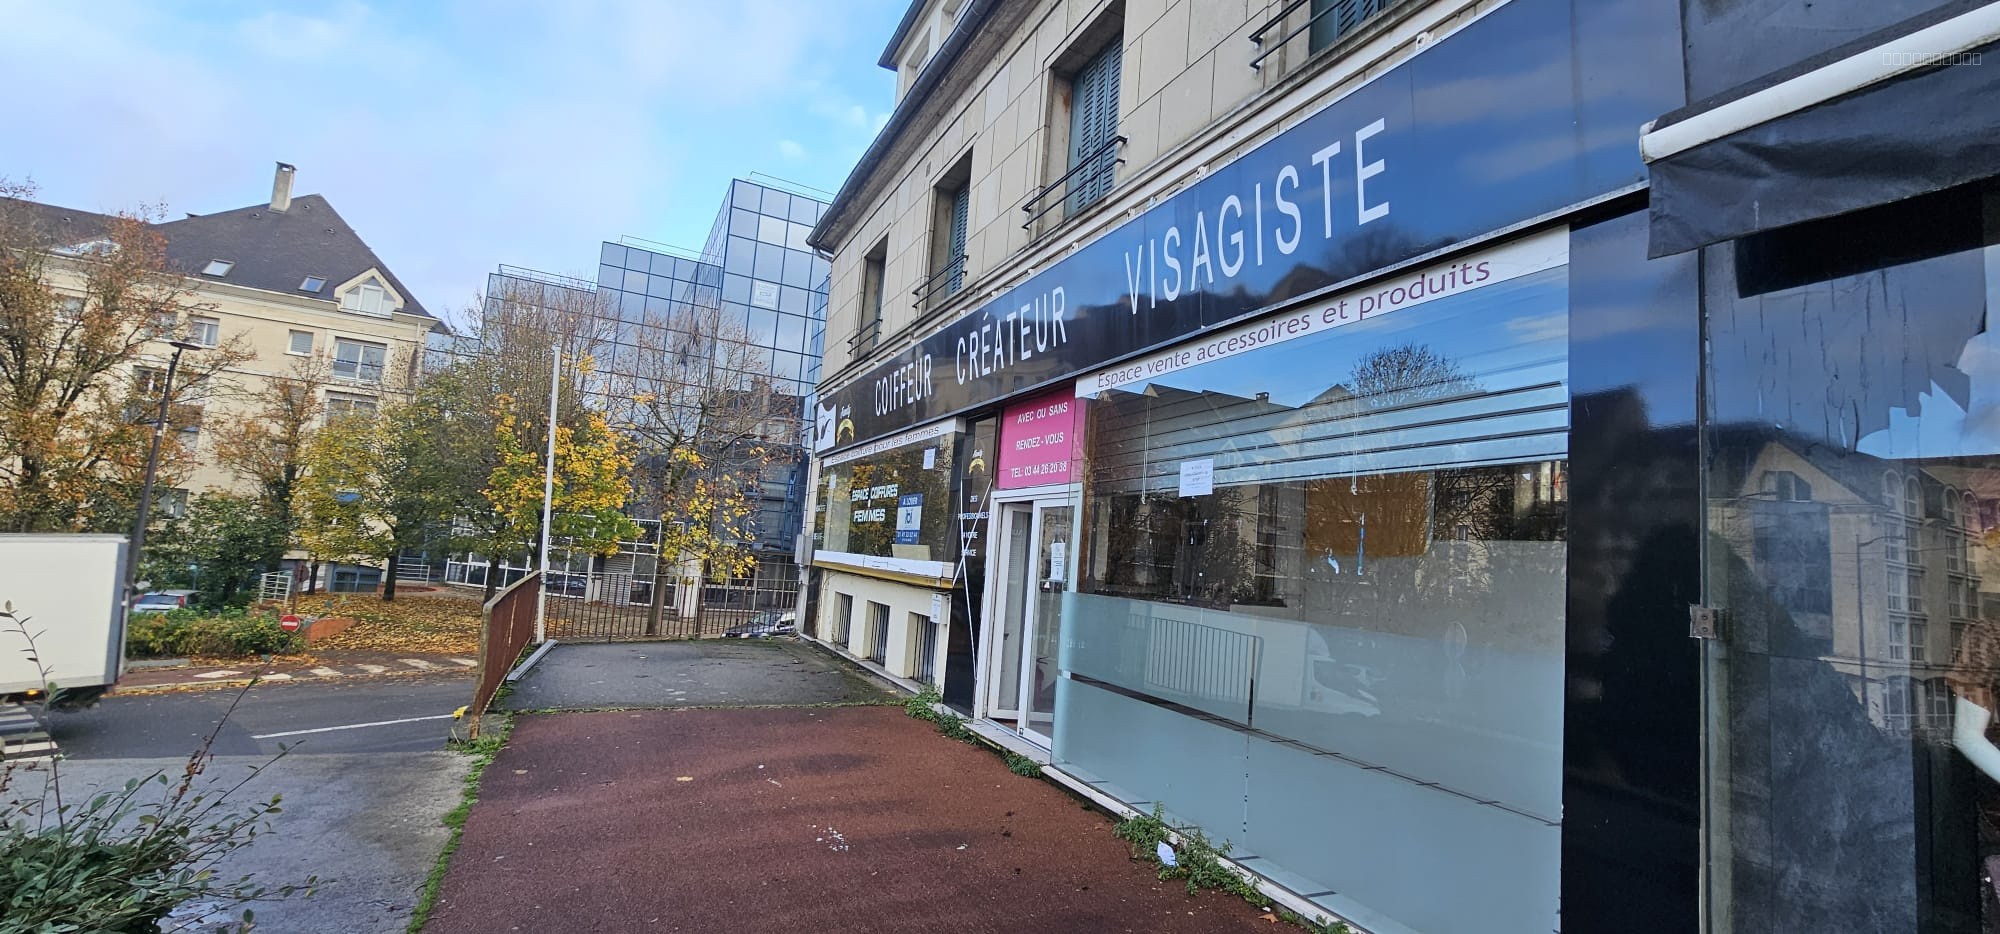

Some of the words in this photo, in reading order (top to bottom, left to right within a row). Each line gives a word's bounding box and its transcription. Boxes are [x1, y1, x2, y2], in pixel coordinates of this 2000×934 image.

[875, 353, 932, 417] COIFFEUR
[956, 286, 1067, 385] CRÉATEUR
[1125, 118, 1390, 315] VISAGISTE
[1097, 361, 1142, 388] Espace
[1147, 349, 1190, 375] vente
[1197, 315, 1310, 361] accessoires
[1322, 300, 1349, 324] et
[1359, 260, 1490, 320] produits
[1017, 411, 1034, 424] AVEC
[1036, 408, 1046, 419] OU
[1048, 401, 1068, 416] SANS
[905, 426, 939, 441] femmes
[1024, 466, 1031, 476] 03
[1032, 464, 1040, 474] 44
[1040, 463, 1048, 474] 26
[1050, 462, 1058, 473] 20
[854, 508, 886, 522] FEMMES
